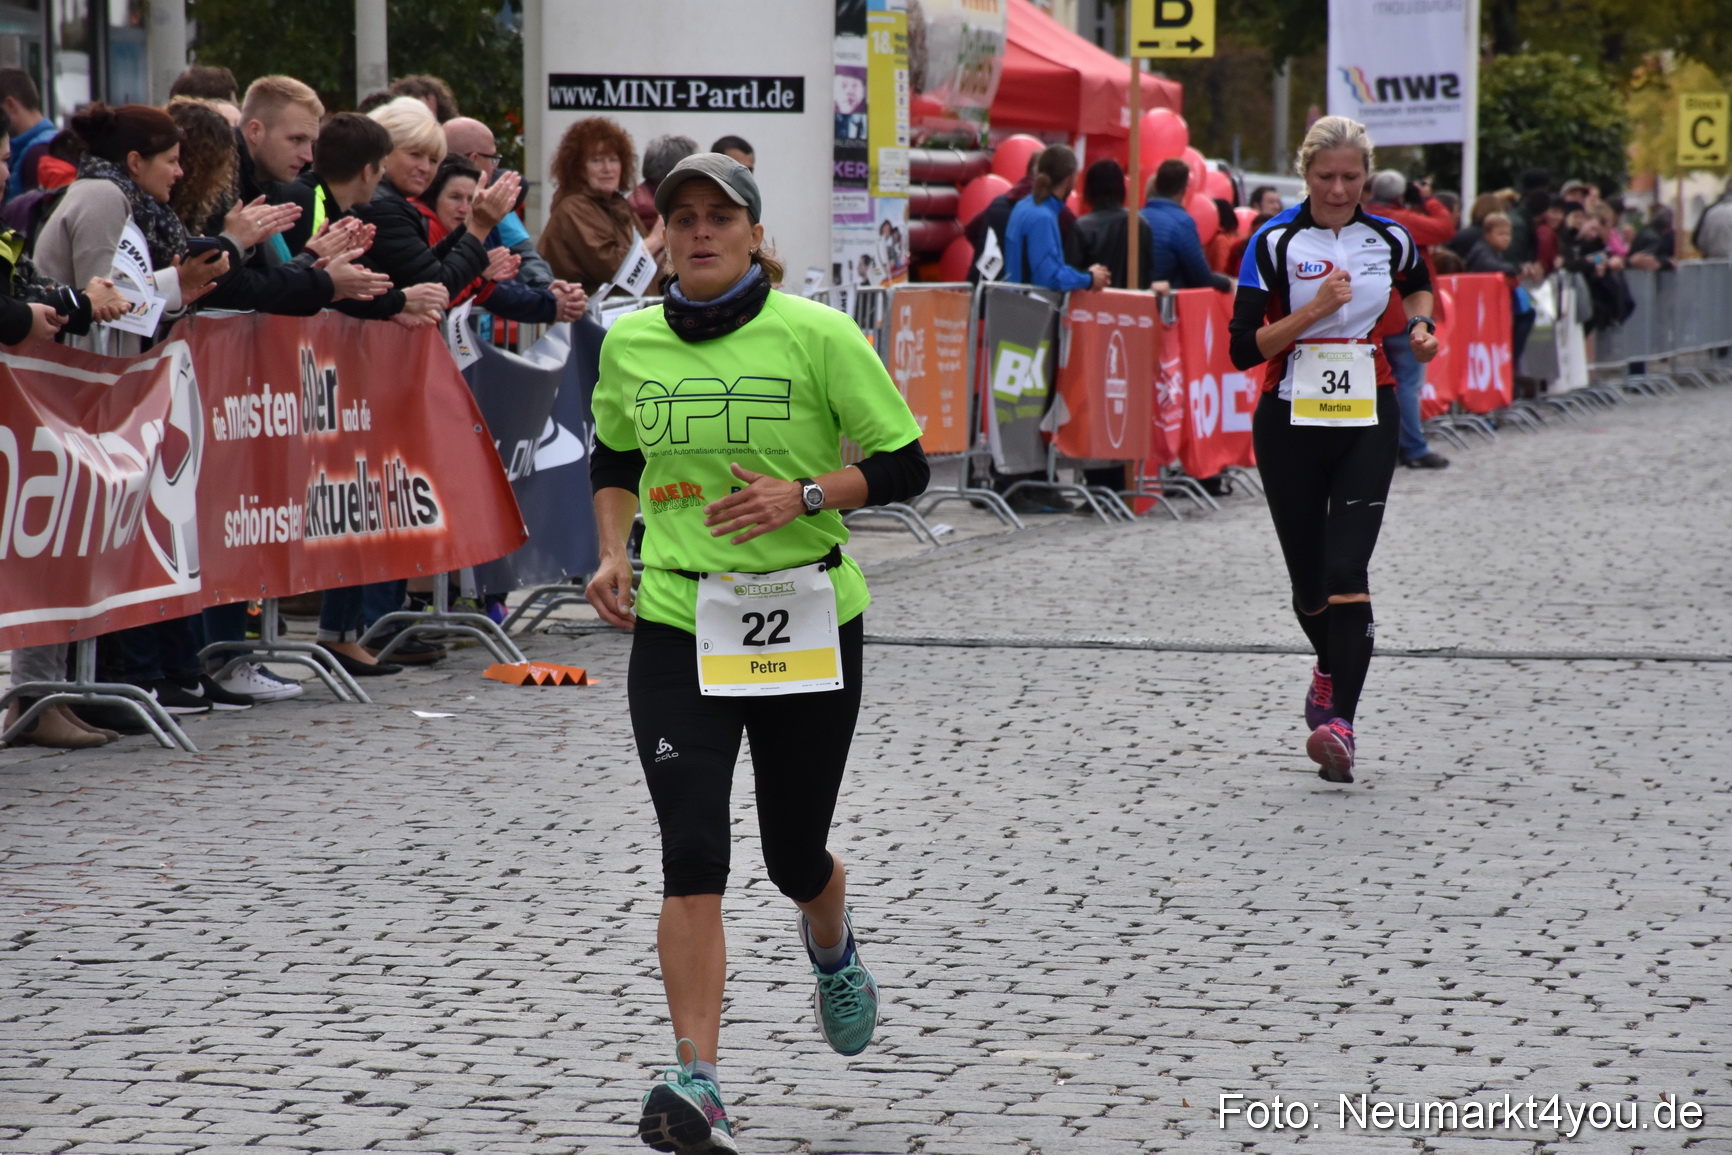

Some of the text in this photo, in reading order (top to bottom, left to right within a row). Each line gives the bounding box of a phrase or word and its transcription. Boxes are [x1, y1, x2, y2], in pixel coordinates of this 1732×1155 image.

[550, 79, 796, 109] www.MINI-Partl.de
[1690, 115, 1715, 149] C
[119, 239, 148, 274] swn
[1297, 261, 1323, 273] tkn
[626, 256, 647, 286] swn
[1321, 369, 1351, 394] 34
[213, 348, 371, 441] die meisten 80er und die
[1319, 402, 1352, 412] Martina
[673, 446, 764, 456] Automatisierungstechnik
[765, 447, 790, 456] GmbH
[225, 457, 439, 548] schönsten aktuellen Hits
[649, 481, 705, 503] MERZ
[650, 495, 701, 515] Reisen
[748, 582, 795, 595] BOCK
[741, 609, 791, 646] 22
[703, 642, 709, 650] D
[750, 660, 787, 674] Petra
